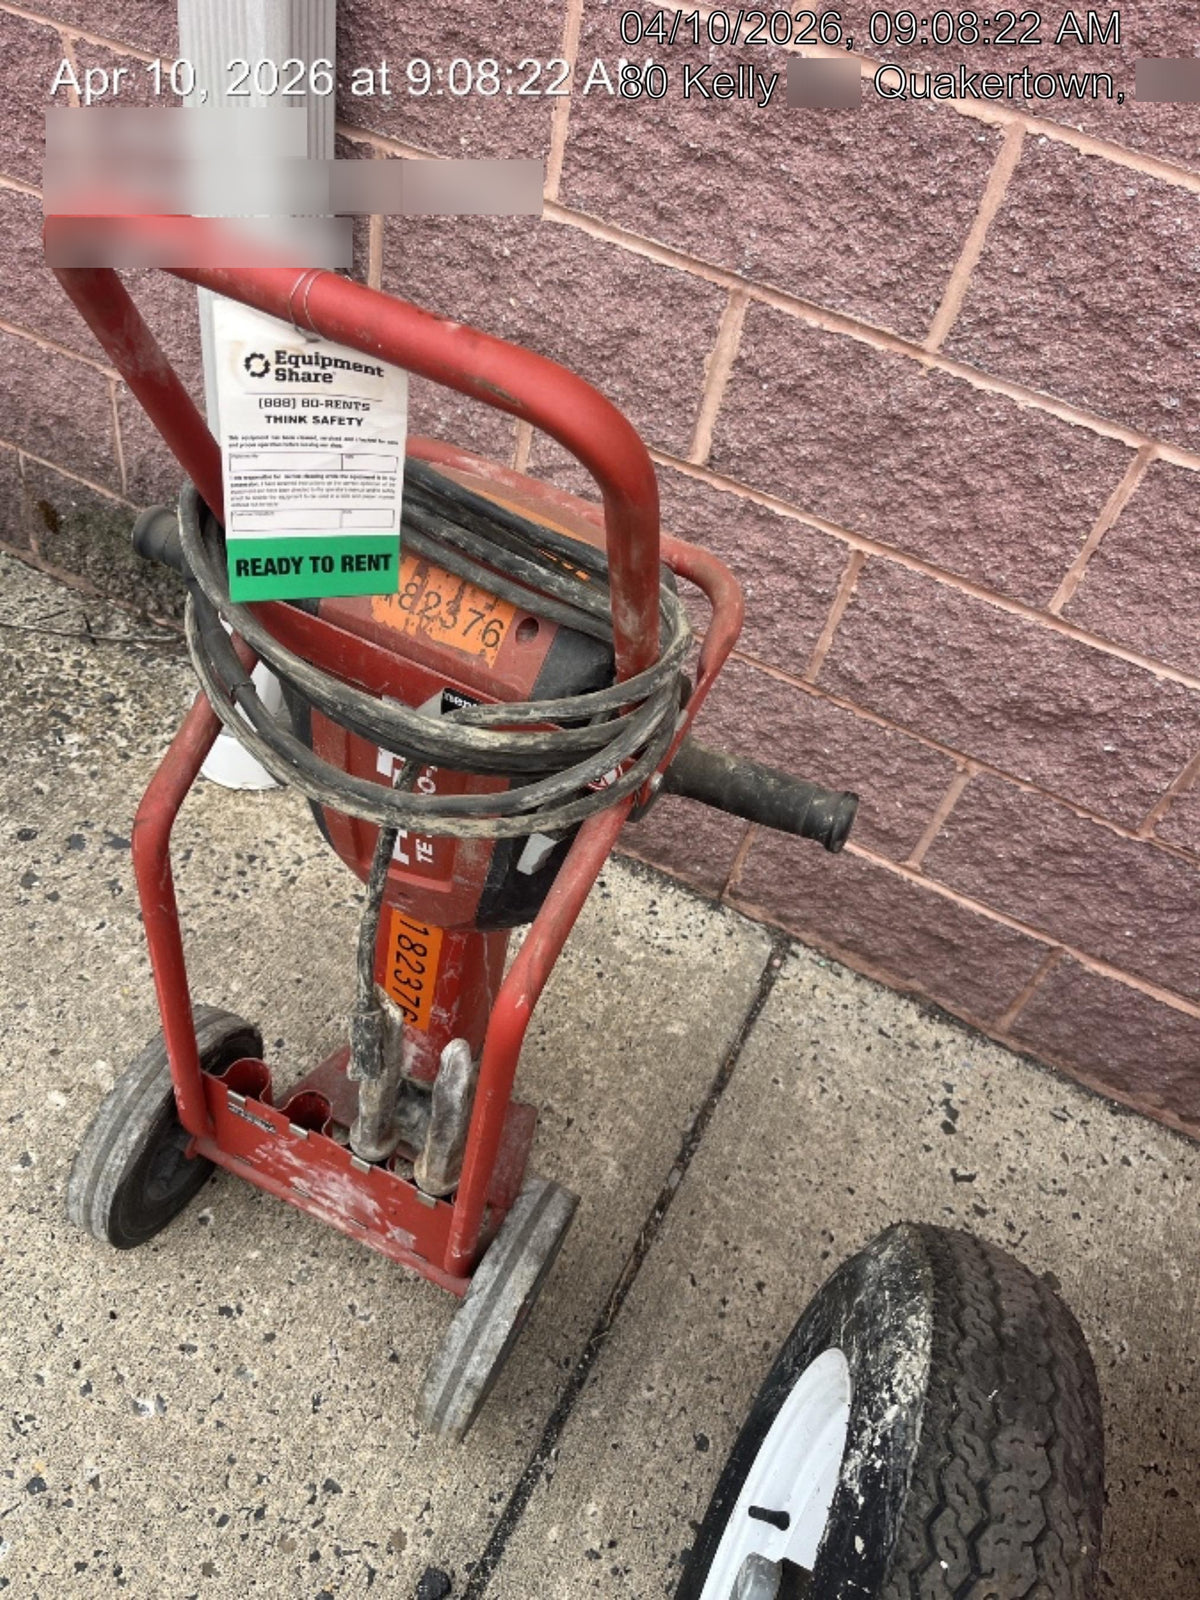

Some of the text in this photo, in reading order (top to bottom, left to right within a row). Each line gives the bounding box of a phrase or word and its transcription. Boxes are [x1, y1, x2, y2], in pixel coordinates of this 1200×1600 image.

[274, 350, 385, 378] Equipment
[274, 367, 334, 384] Share
[264, 415, 364, 427] THINK SAFETY
[235, 553, 393, 578] READY TO RENT
